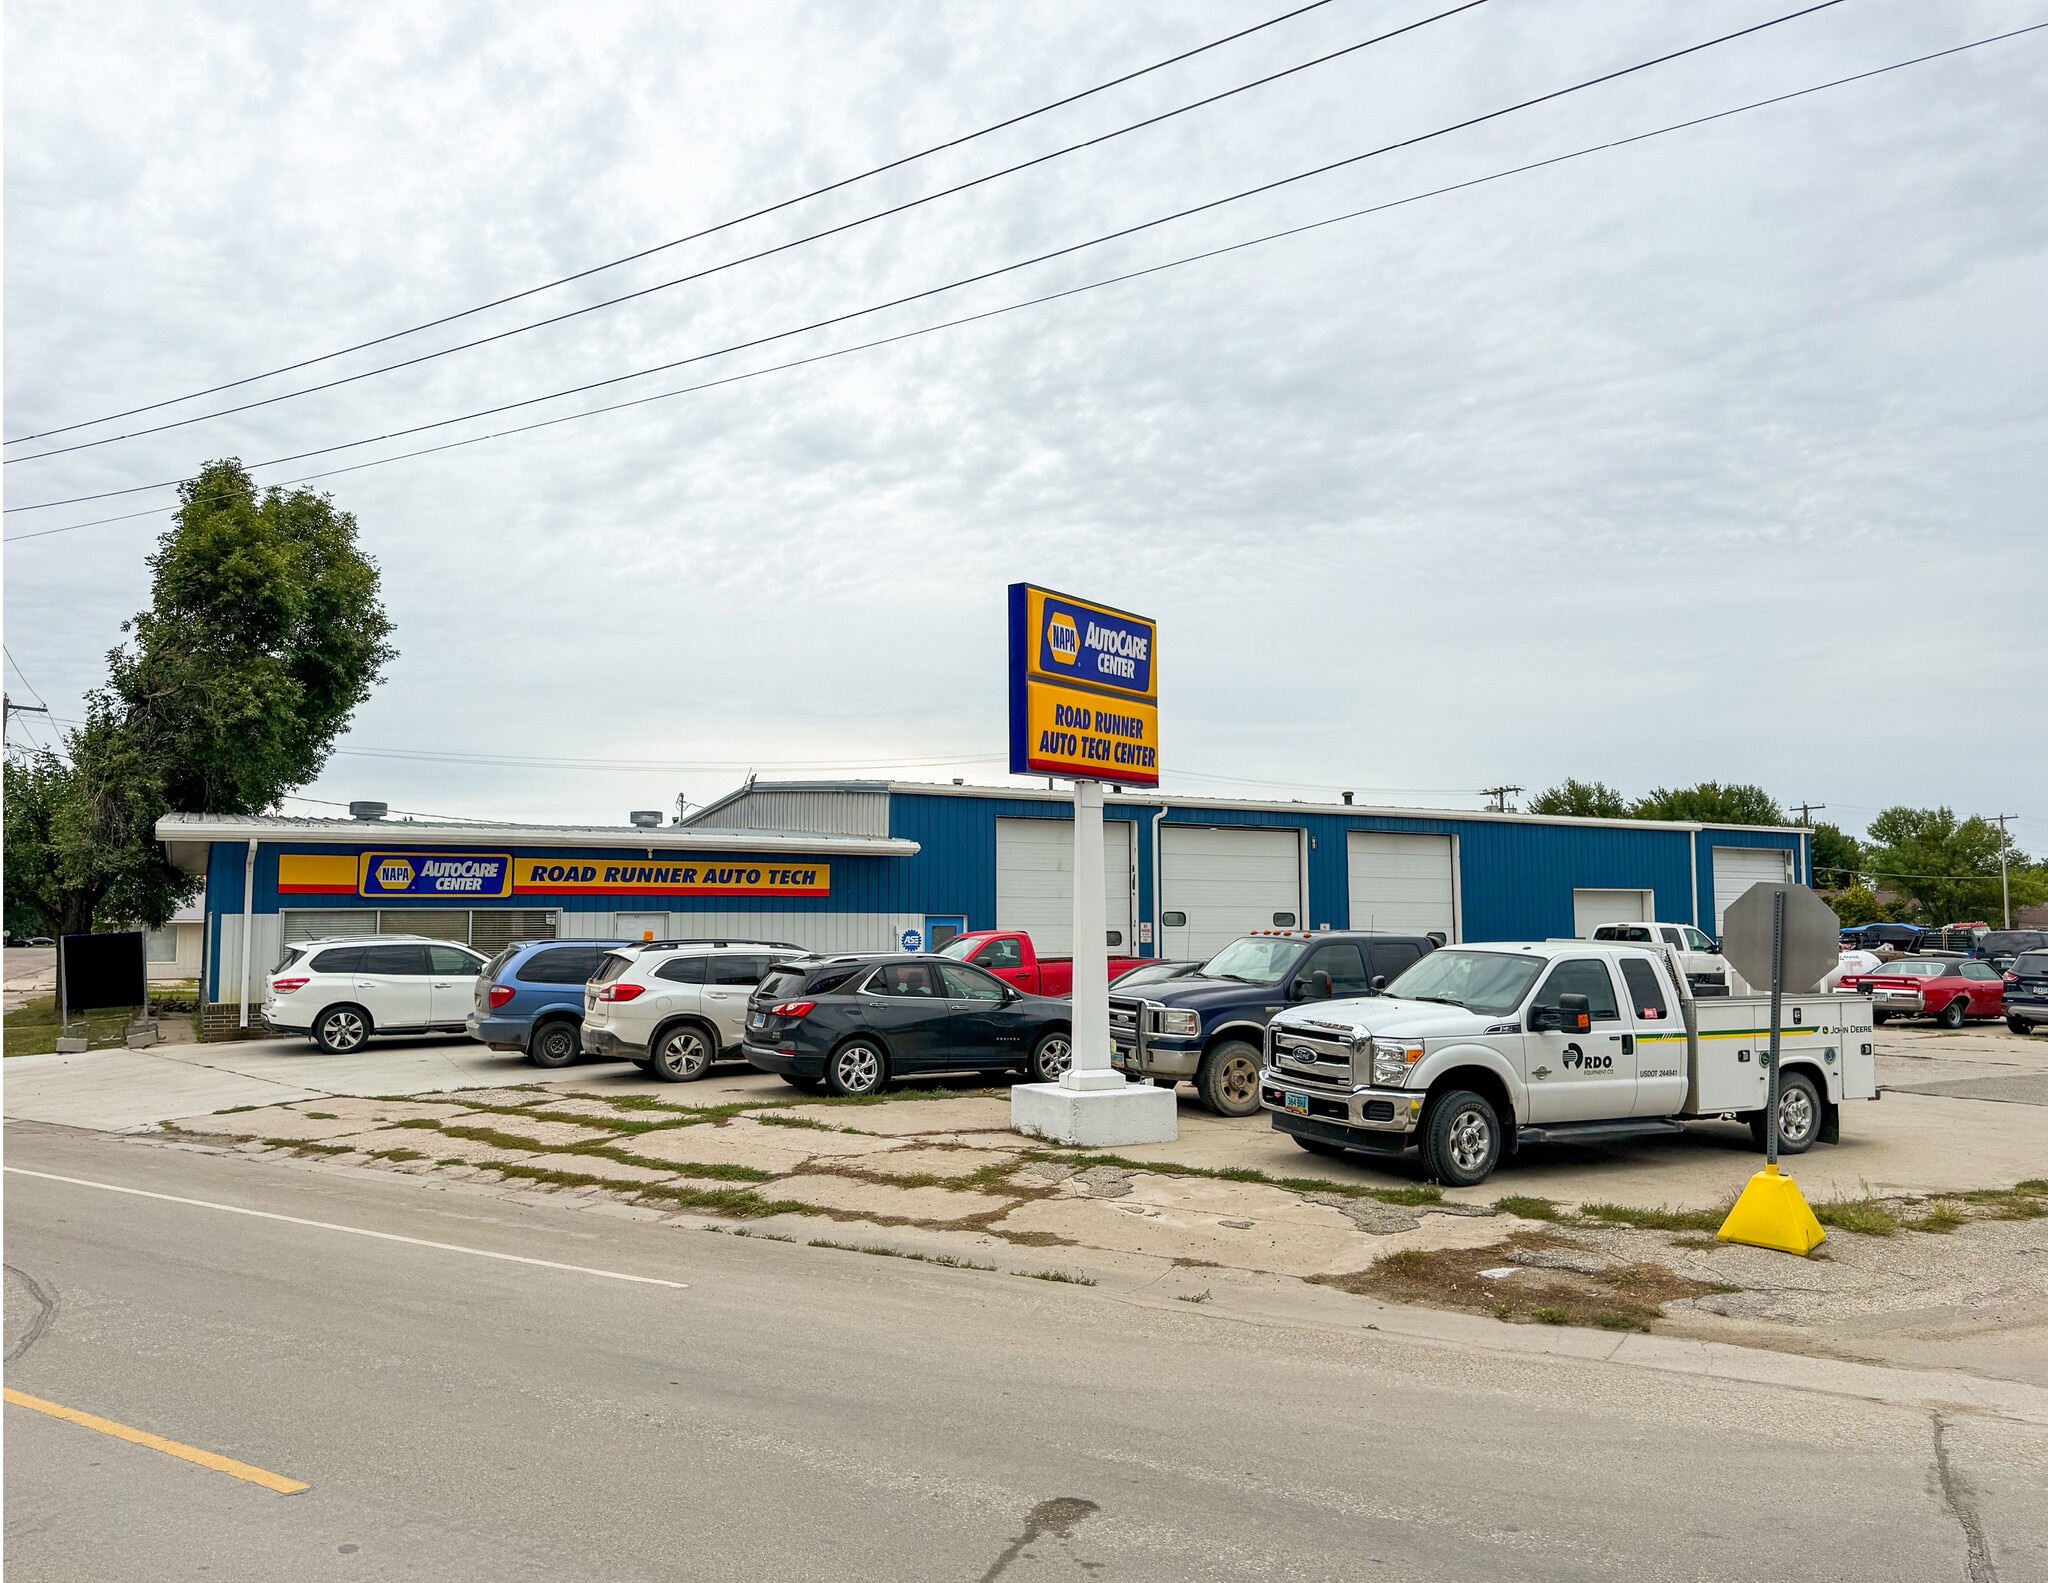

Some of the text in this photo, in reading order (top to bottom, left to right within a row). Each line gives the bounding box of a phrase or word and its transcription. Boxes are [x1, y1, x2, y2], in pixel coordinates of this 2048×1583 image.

[1052, 624, 1077, 653] NAPA
[1097, 653, 1135, 679] CENTER
[1055, 703, 1143, 740] ROAD RUNNER
[1039, 730, 1156, 768] AUTO TECH CENTER
[381, 867, 410, 881] NAPA
[530, 865, 817, 885] ROAD RUNNER AUTO TECH
[435, 877, 483, 891] CENTER
[1850, 1025, 1872, 1033] DEERE
[1584, 1055, 1613, 1069] RDO
[1640, 1070, 1658, 1078] USDOT
